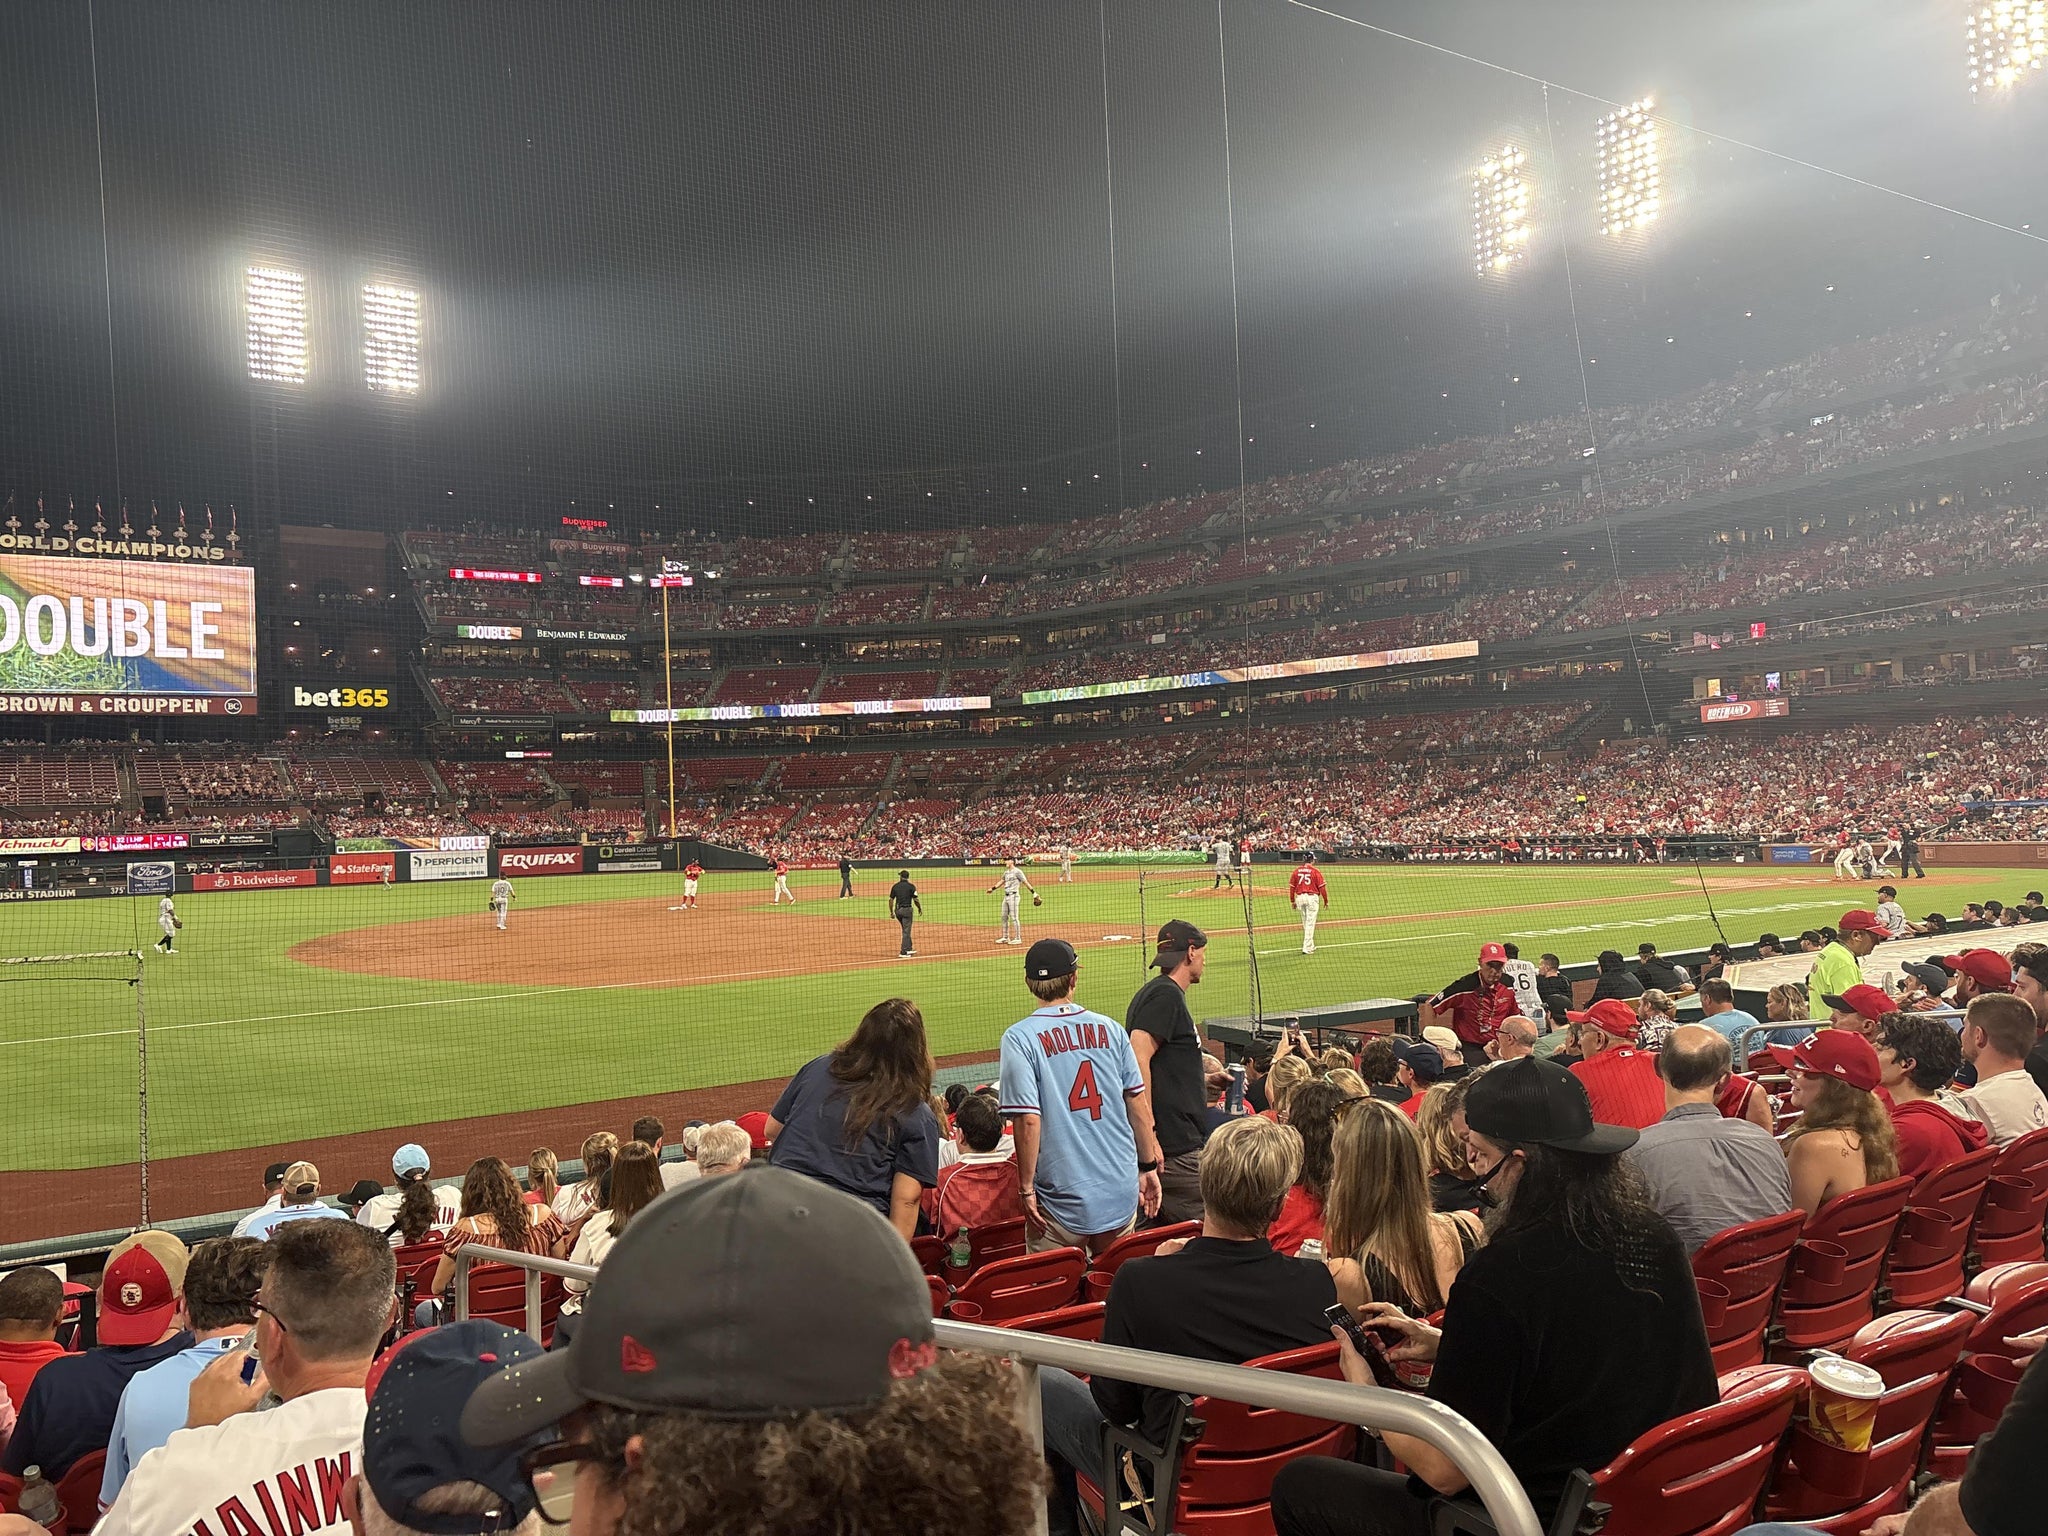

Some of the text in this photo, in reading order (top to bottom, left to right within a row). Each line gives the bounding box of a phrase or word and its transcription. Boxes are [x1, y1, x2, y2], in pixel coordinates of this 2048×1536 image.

[562, 517, 608, 527] BUDWEISER
[0, 534, 224, 560] ORLD CHAMPIONS
[582, 542, 626, 552] BUDWEISER
[0, 594, 225, 660] DOUBLE
[468, 625, 512, 640] DOUBLE
[537, 629, 626, 641] BENJAMIN F. EDWARDS
[1173, 672, 1211, 688] DOUBLE
[1388, 648, 1433, 666] DOUBLE
[294, 686, 389, 708] bet365
[0, 696, 209, 713] BROWN & CROUPPEN
[638, 697, 963, 723] DOUBLE DOUBLE DOUBLE DOUBLE DOUBLE
[327, 716, 362, 724] bet365
[0, 838, 72, 849] Schnucks
[440, 836, 486, 850] DOUBLE
[425, 856, 485, 866] PERFICIENT
[501, 852, 577, 869] EQUIFAX
[137, 866, 165, 876] Ford
[233, 875, 298, 886] Budweiser
[1297, 873, 1311, 885] 75
[28, 889, 76, 899] STADIUM
[1037, 1023, 1110, 1058] MOLINA
[1068, 1059, 1103, 1121] 4
[189, 1451, 352, 1536] AINW
